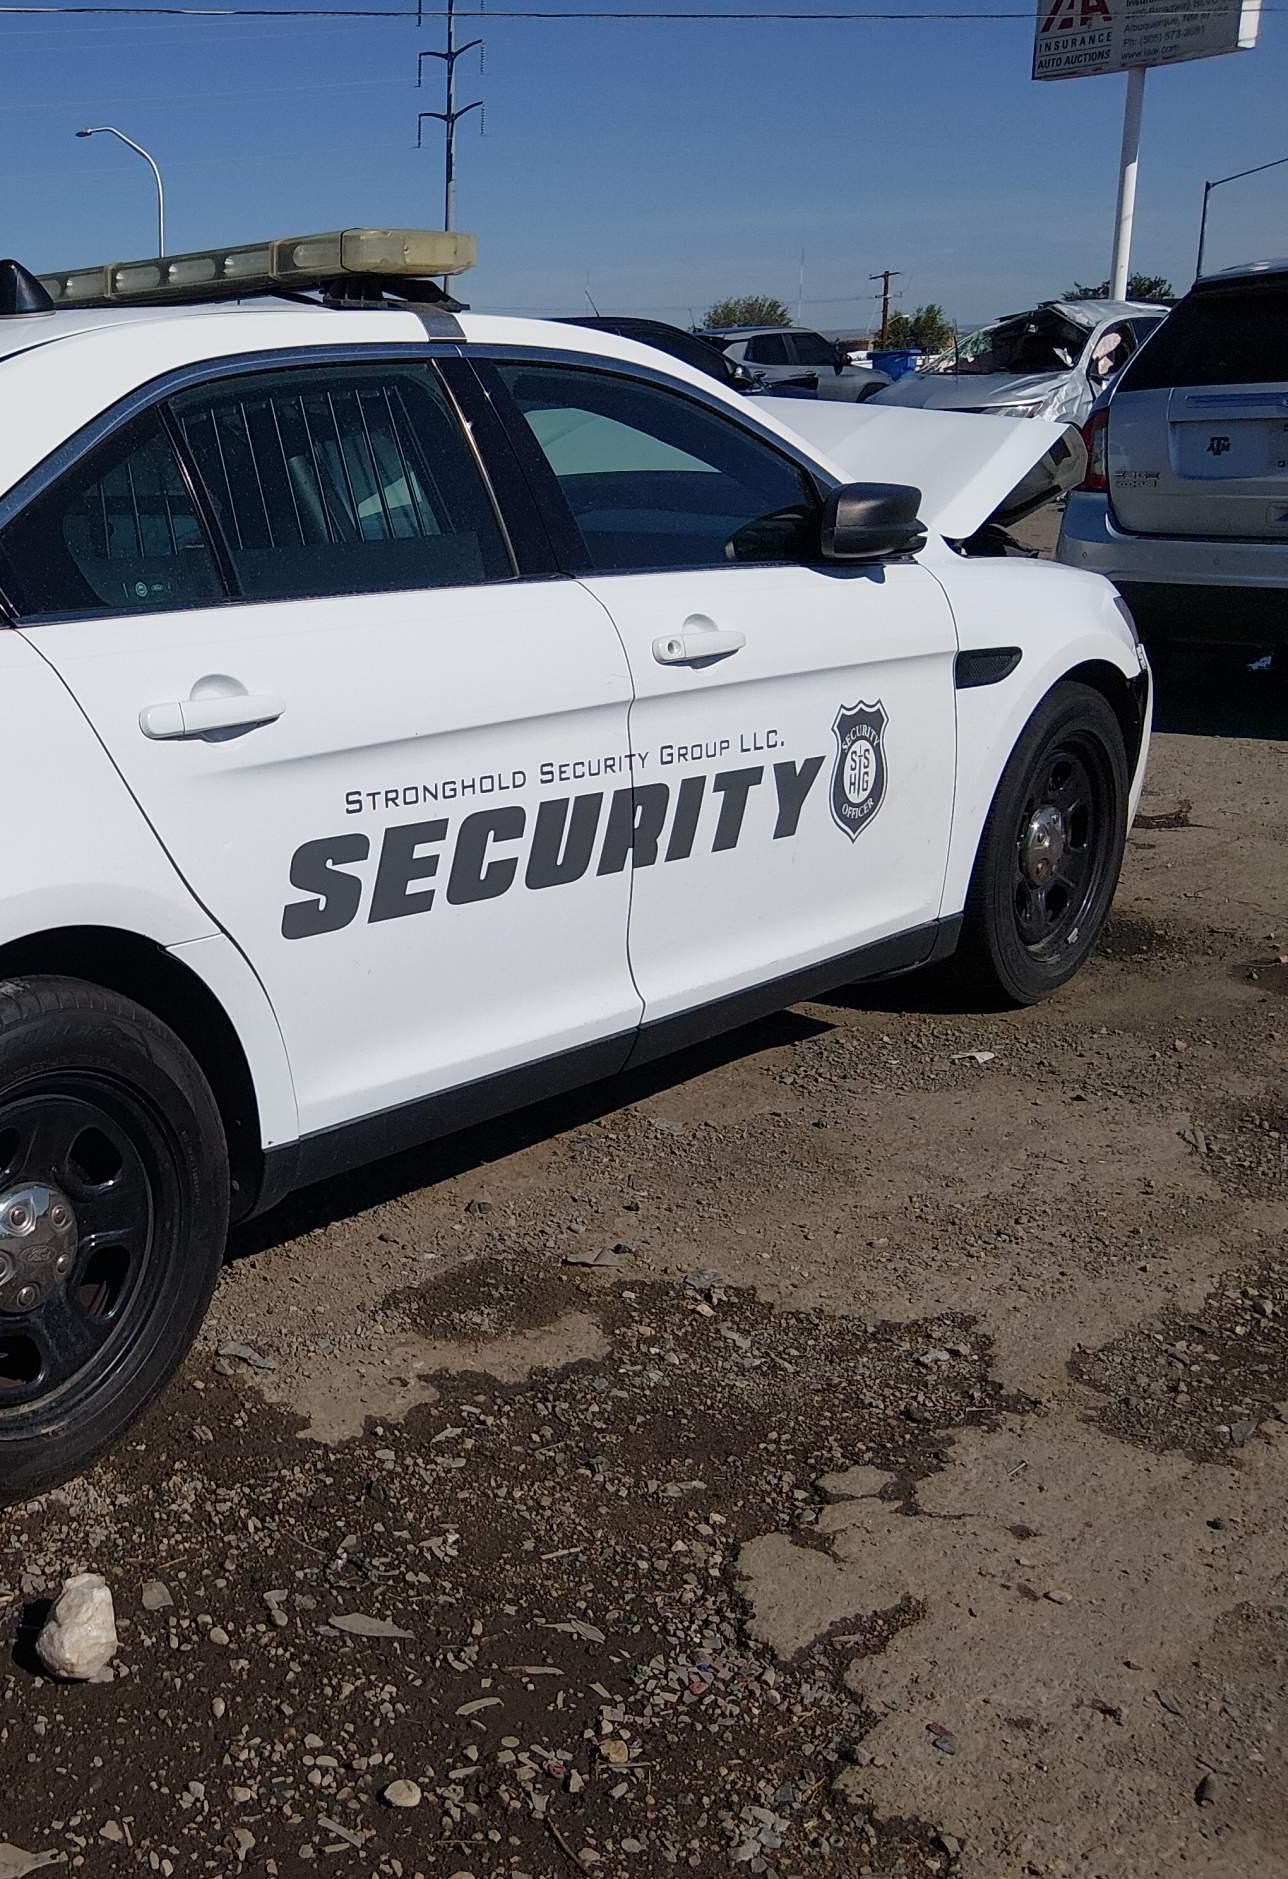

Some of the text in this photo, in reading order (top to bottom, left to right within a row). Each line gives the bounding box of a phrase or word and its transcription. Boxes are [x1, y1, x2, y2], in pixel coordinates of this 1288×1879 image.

[1039, 31, 1112, 53] INSURANCE
[1037, 49, 1111, 69] AUTO AUCTIONS
[842, 724, 880, 753] SECURITY
[345, 729, 785, 815] STRONGHOLD SECURITY GROUP LLC.
[842, 797, 874, 819] OFFICER
[281, 755, 826, 940] SECURITY
